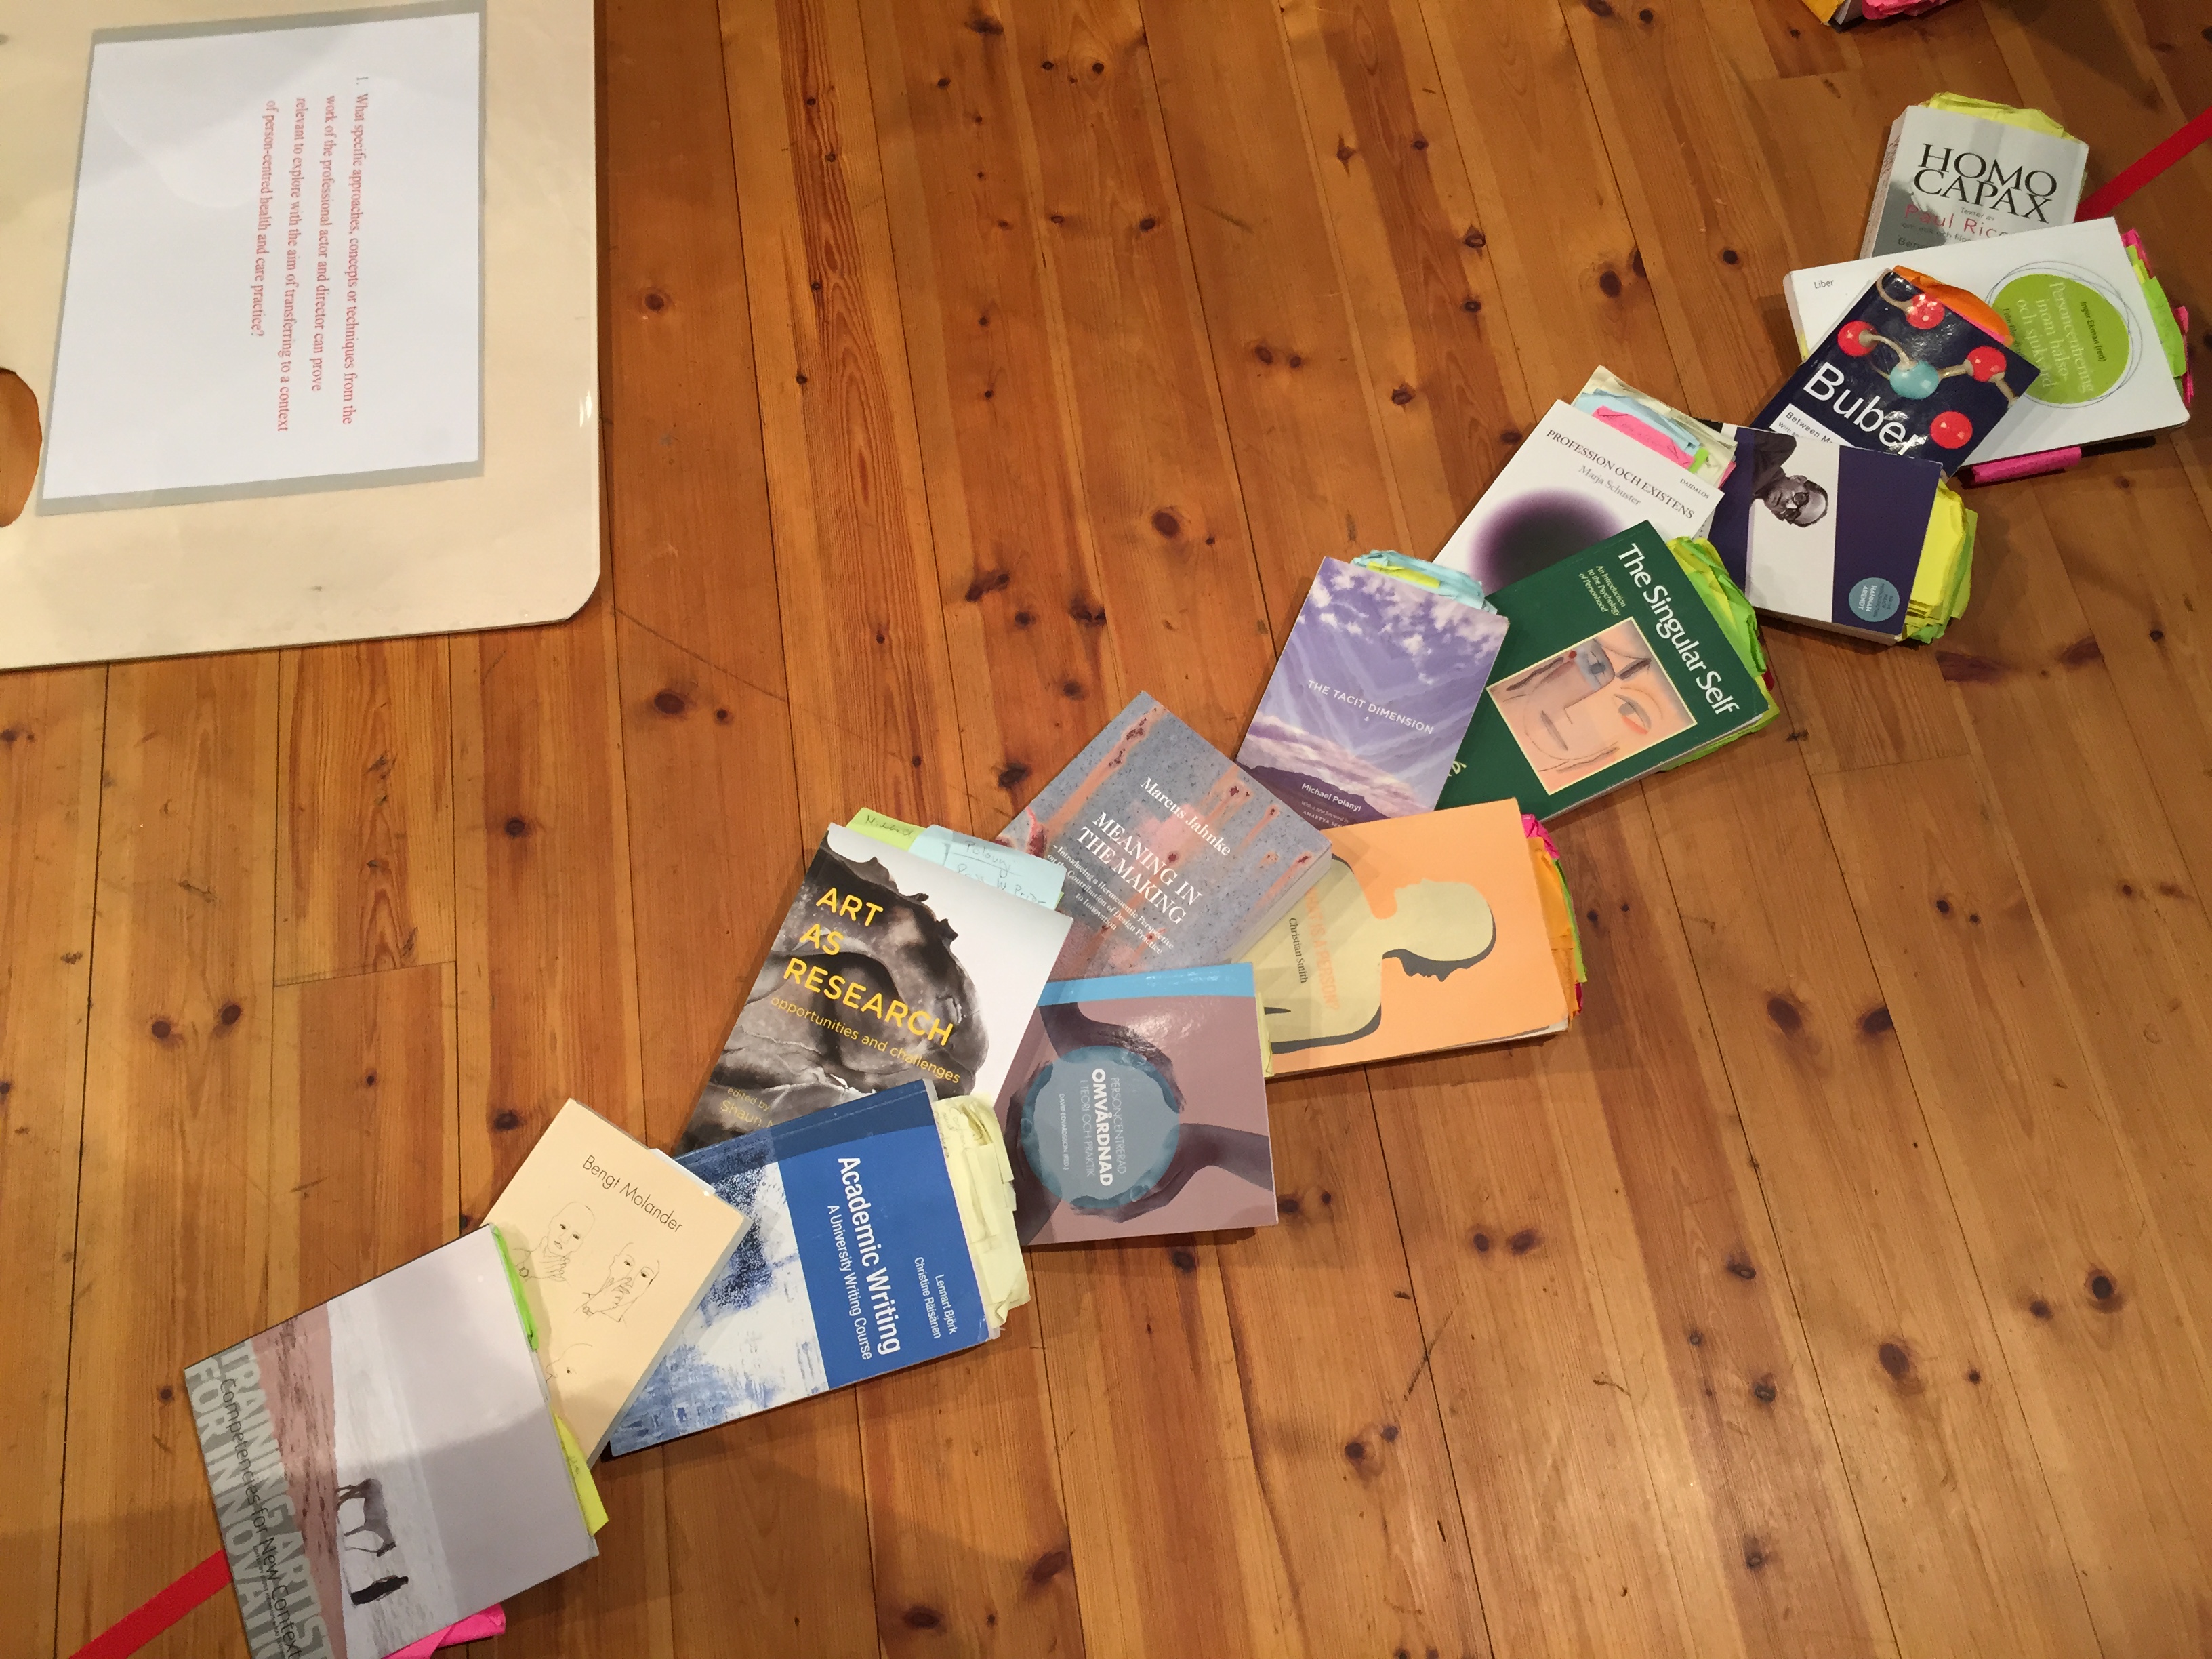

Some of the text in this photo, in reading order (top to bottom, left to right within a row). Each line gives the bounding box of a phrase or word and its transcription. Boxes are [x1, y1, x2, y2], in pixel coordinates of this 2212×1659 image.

[294, 98, 307, 141] relevant
[354, 93, 368, 122] What
[293, 143, 304, 155] to
[351, 124, 367, 167] specific
[288, 157, 304, 198] explore
[1914, 159, 2052, 224] CAPAX
[1919, 143, 2057, 205] HOMO
[250, 100, 277, 337] of person-centred health and care practice?
[289, 201, 302, 226] with
[348, 169, 364, 235] approaches,
[1905, 203, 2010, 237] Paul Ric
[287, 228, 300, 246] the
[309, 95, 337, 391] work of the professional actor and director can prove
[285, 274, 298, 287] of
[286, 249, 297, 271] aim
[344, 237, 359, 287] concepts
[347, 291, 357, 303] or
[1814, 279, 1834, 289] Liber
[277, 289, 297, 357] transferring
[2016, 299, 2034, 325] och
[2036, 298, 2056, 337] inom
[2081, 301, 2107, 362] Inger Ekman (red)
[341, 306, 359, 369] techniques
[2049, 281, 2095, 394] Personcentrering
[281, 361, 292, 372] to
[343, 373, 356, 402] from
[277, 386, 290, 432] context
[342, 405, 355, 424] the
[1777, 422, 1792, 433] With
[1785, 411, 1820, 438] Between
[1803, 361, 1925, 456] Buber
[1546, 429, 1614, 470] PROFESSION
[1614, 467, 1642, 487] OCH
[1641, 482, 1694, 519] EXISTENS
[1578, 465, 1641, 505] Marja Schuster
[1679, 478, 1709, 499] DAIDALOS
[1578, 573, 1609, 613] of Personhood
[1587, 568, 1621, 616] to the Psychology
[1595, 565, 1626, 607] An Introduction
[1866, 585, 1877, 611] HANNAH
[1618, 542, 1740, 715] The Singular Self
[1308, 679, 1434, 735] THE TACIT DIMENSION
[1139, 777, 1231, 856] Marcus Jahnke
[1301, 783, 1361, 812] Michael Polanyi
[1076, 826, 1187, 924] THE MAKING
[1092, 811, 1202, 905] MEANING IN
[816, 888, 883, 927] ART
[1046, 853, 1163, 955] on th Contribution of Design Practice
[1055, 846, 1095, 882] Introducing
[1097, 881, 1136, 916] Hermeneutic
[1135, 915, 1175, 951] Perspective
[1074, 892, 1118, 931] to Innovation
[799, 924, 844, 956] AS
[1288, 918, 1309, 984] Christian Smith
[1310, 923, 1326, 938] IS
[1313, 939, 1326, 948] A
[783, 957, 954, 1046] RESEARCH
[1316, 950, 1340, 1010] PERSON?
[771, 996, 961, 1084] opportunities and challenges
[720, 1100, 763, 1125] Shaun
[726, 1087, 772, 1112] edited by
[1080, 1086, 1090, 1111] TEORI
[1059, 1112, 1068, 1152] EDVARDSSON
[1082, 1114, 1092, 1138] OCH
[1092, 1068, 1113, 1186] OMVÅRDNAD
[1110, 1077, 1126, 1174] PERSONCENTRERAD
[1084, 1141, 1094, 1176] PRAKTIK
[582, 1154, 683, 1233] Bengt Molander
[838, 1158, 901, 1355] Academic Writing
[827, 1205, 872, 1360] A University Writing Course
[914, 1256, 941, 1339] Christine Räisänen
[935, 1274, 958, 1334] Lennart Björk
[220, 1378, 260, 1505] Competencies
[252, 1505, 269, 1536] for
[260, 1536, 280, 1581] New
